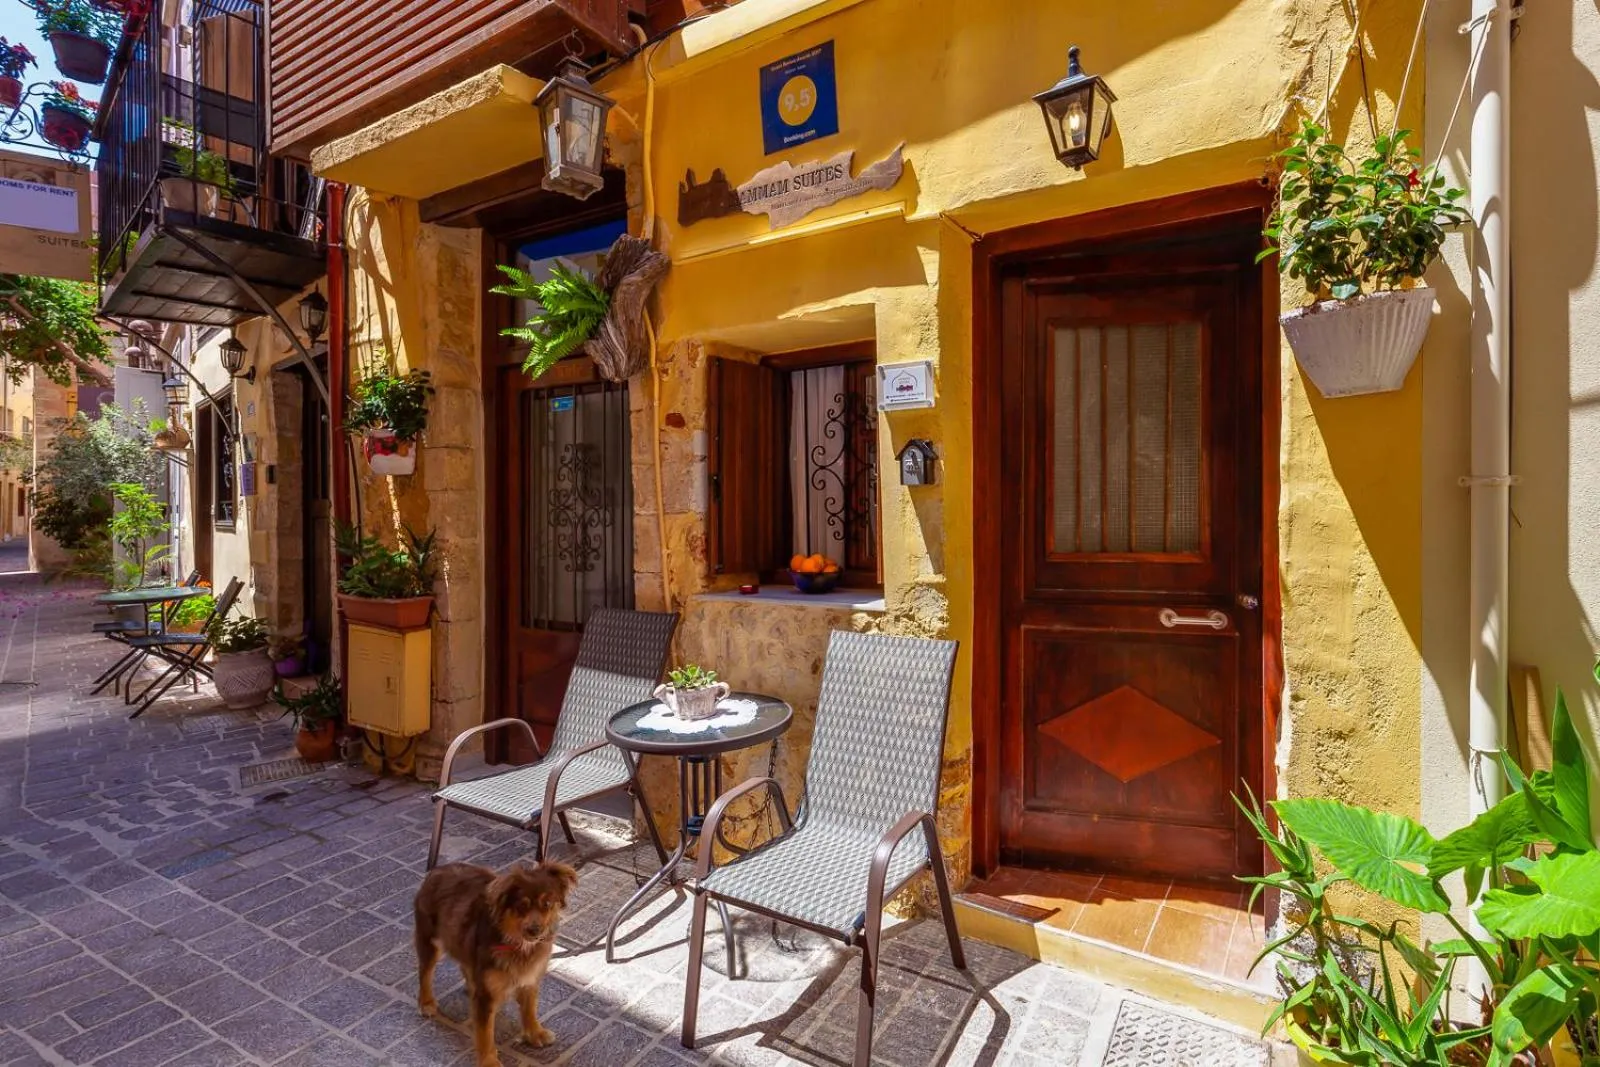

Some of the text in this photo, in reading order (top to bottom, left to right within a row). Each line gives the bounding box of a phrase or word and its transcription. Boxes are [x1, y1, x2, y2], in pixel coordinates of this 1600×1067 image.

[784, 88, 811, 112] 9,5
[783, 128, 816, 144] Booking.com
[793, 164, 844, 191] SUITES
[0, 180, 74, 197] OMS FOR RENT
